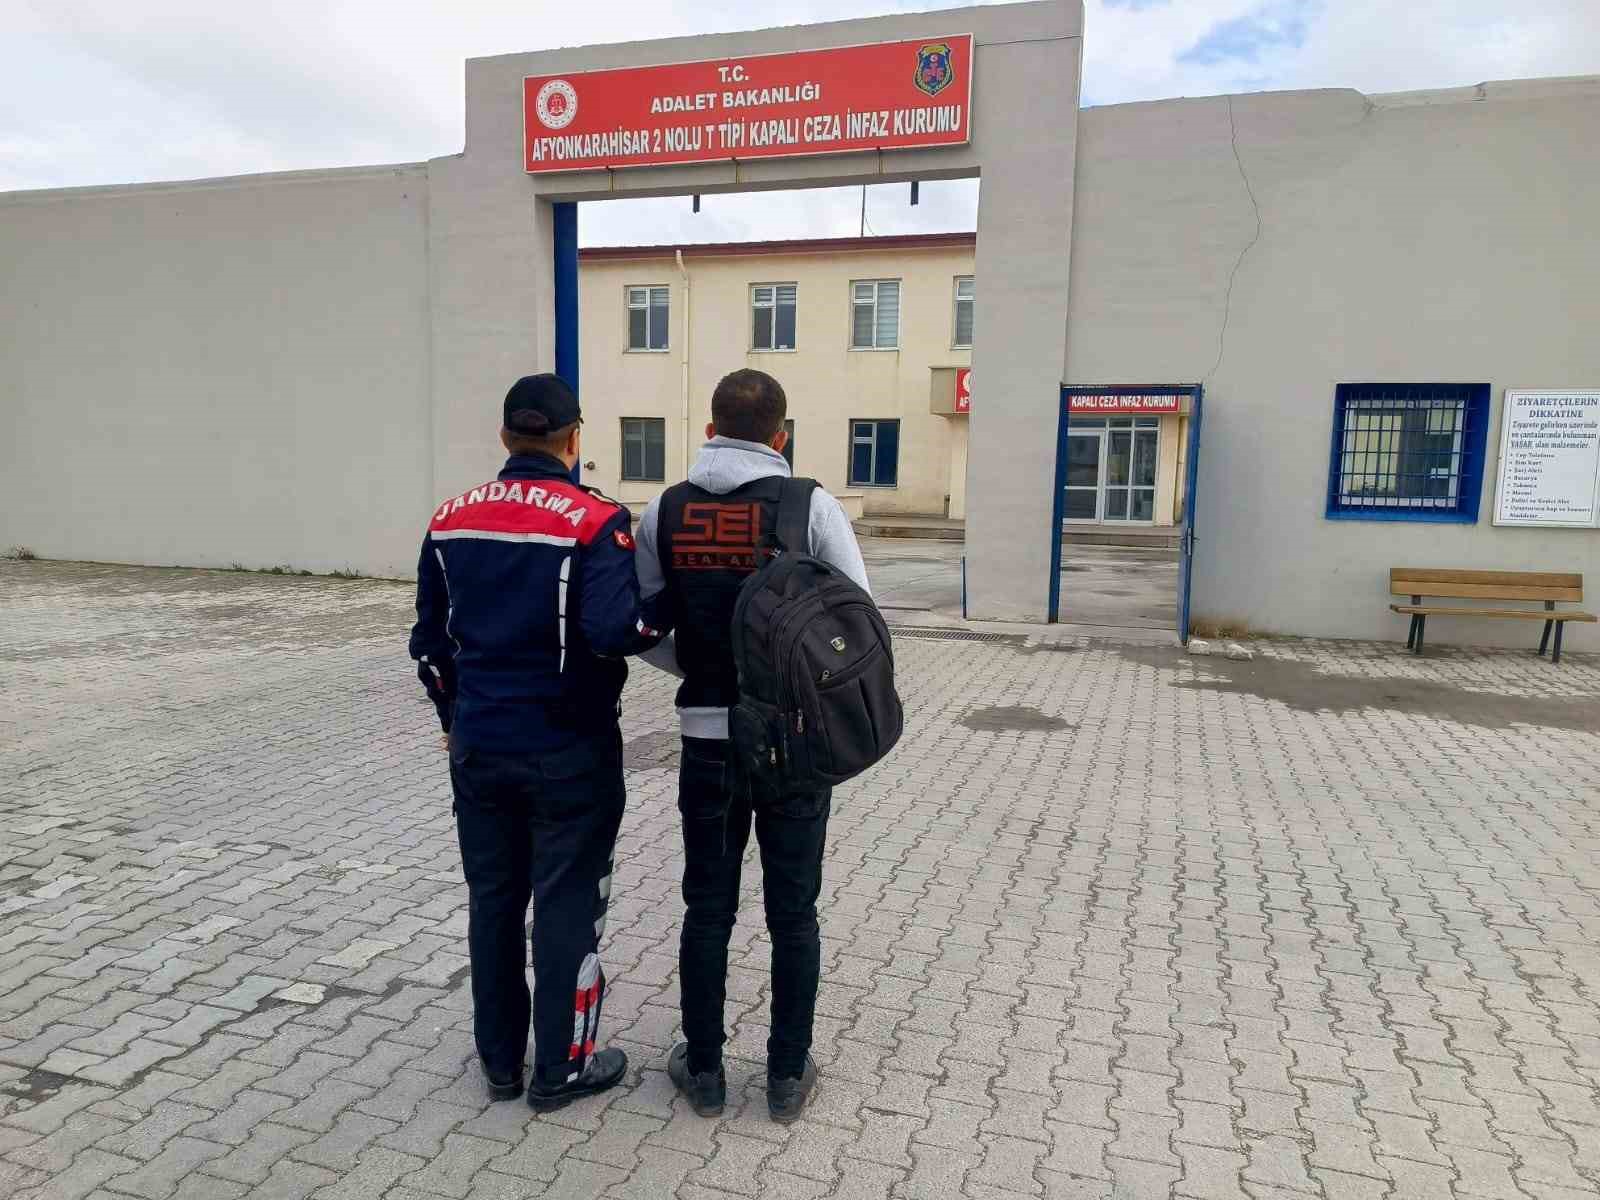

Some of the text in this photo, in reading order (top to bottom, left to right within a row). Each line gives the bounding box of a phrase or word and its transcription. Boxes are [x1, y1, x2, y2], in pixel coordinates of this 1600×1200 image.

[718, 65, 749, 83] T.C.
[651, 81, 820, 114] ADALET BAKANLIĞI
[532, 105, 961, 161] AFYONKARAHİSAR 2 NOLU T TİPİ KAPALI CEZA İNFAZ KURUMU
[1071, 395, 1097, 408] KAPALI
[1098, 395, 1118, 408] CEZA
[1143, 395, 1176, 408] KURUMU
[434, 481, 587, 527] JANDARMA
